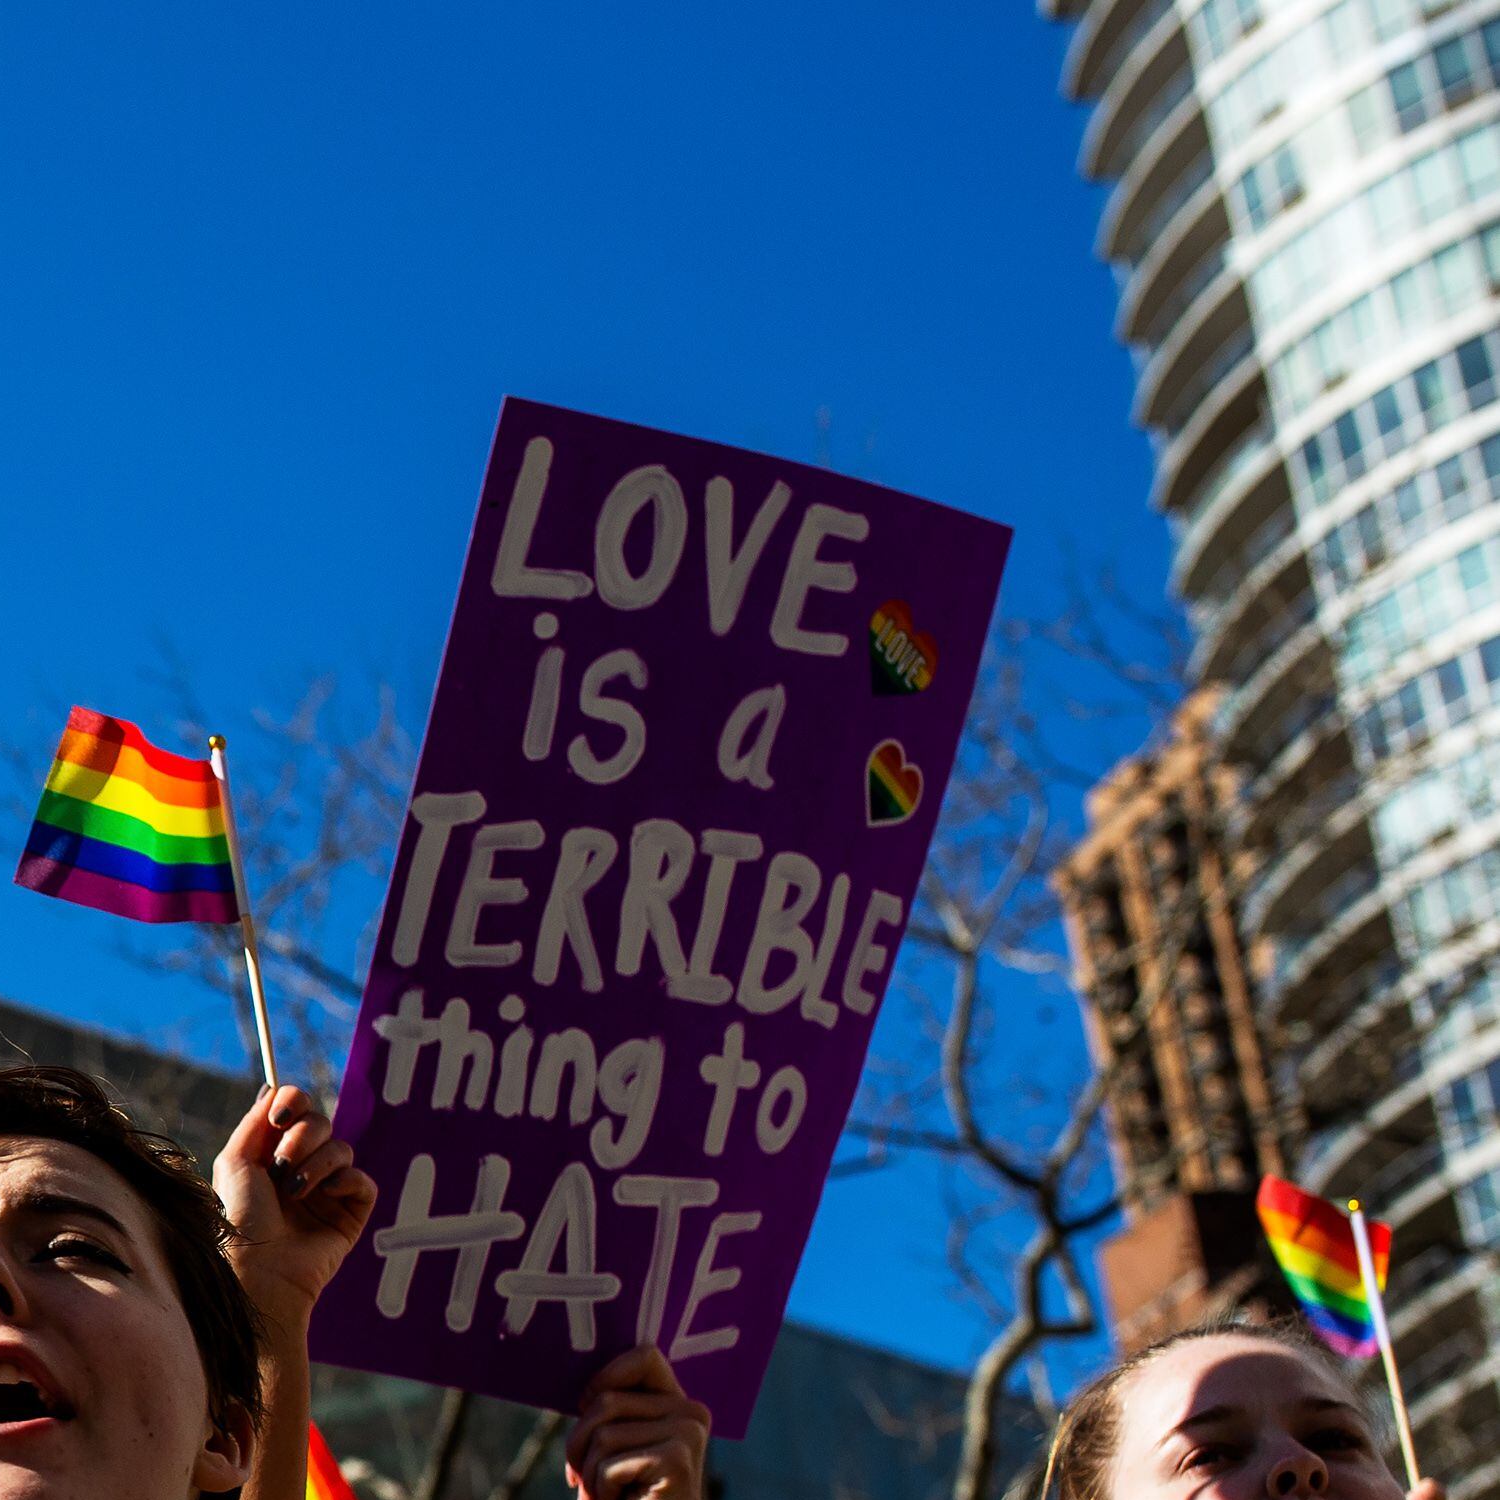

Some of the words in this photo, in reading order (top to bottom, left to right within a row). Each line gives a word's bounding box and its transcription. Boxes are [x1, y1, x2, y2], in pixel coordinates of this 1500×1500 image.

[491, 437, 870, 656] LOVE
[717, 684, 787, 790] a
[874, 617, 927, 691] LOVE
[391, 790, 903, 1029] TERRIBLE
[372, 988, 665, 1170] thing
[699, 1021, 807, 1157] to
[373, 1152, 763, 1362] HATE
